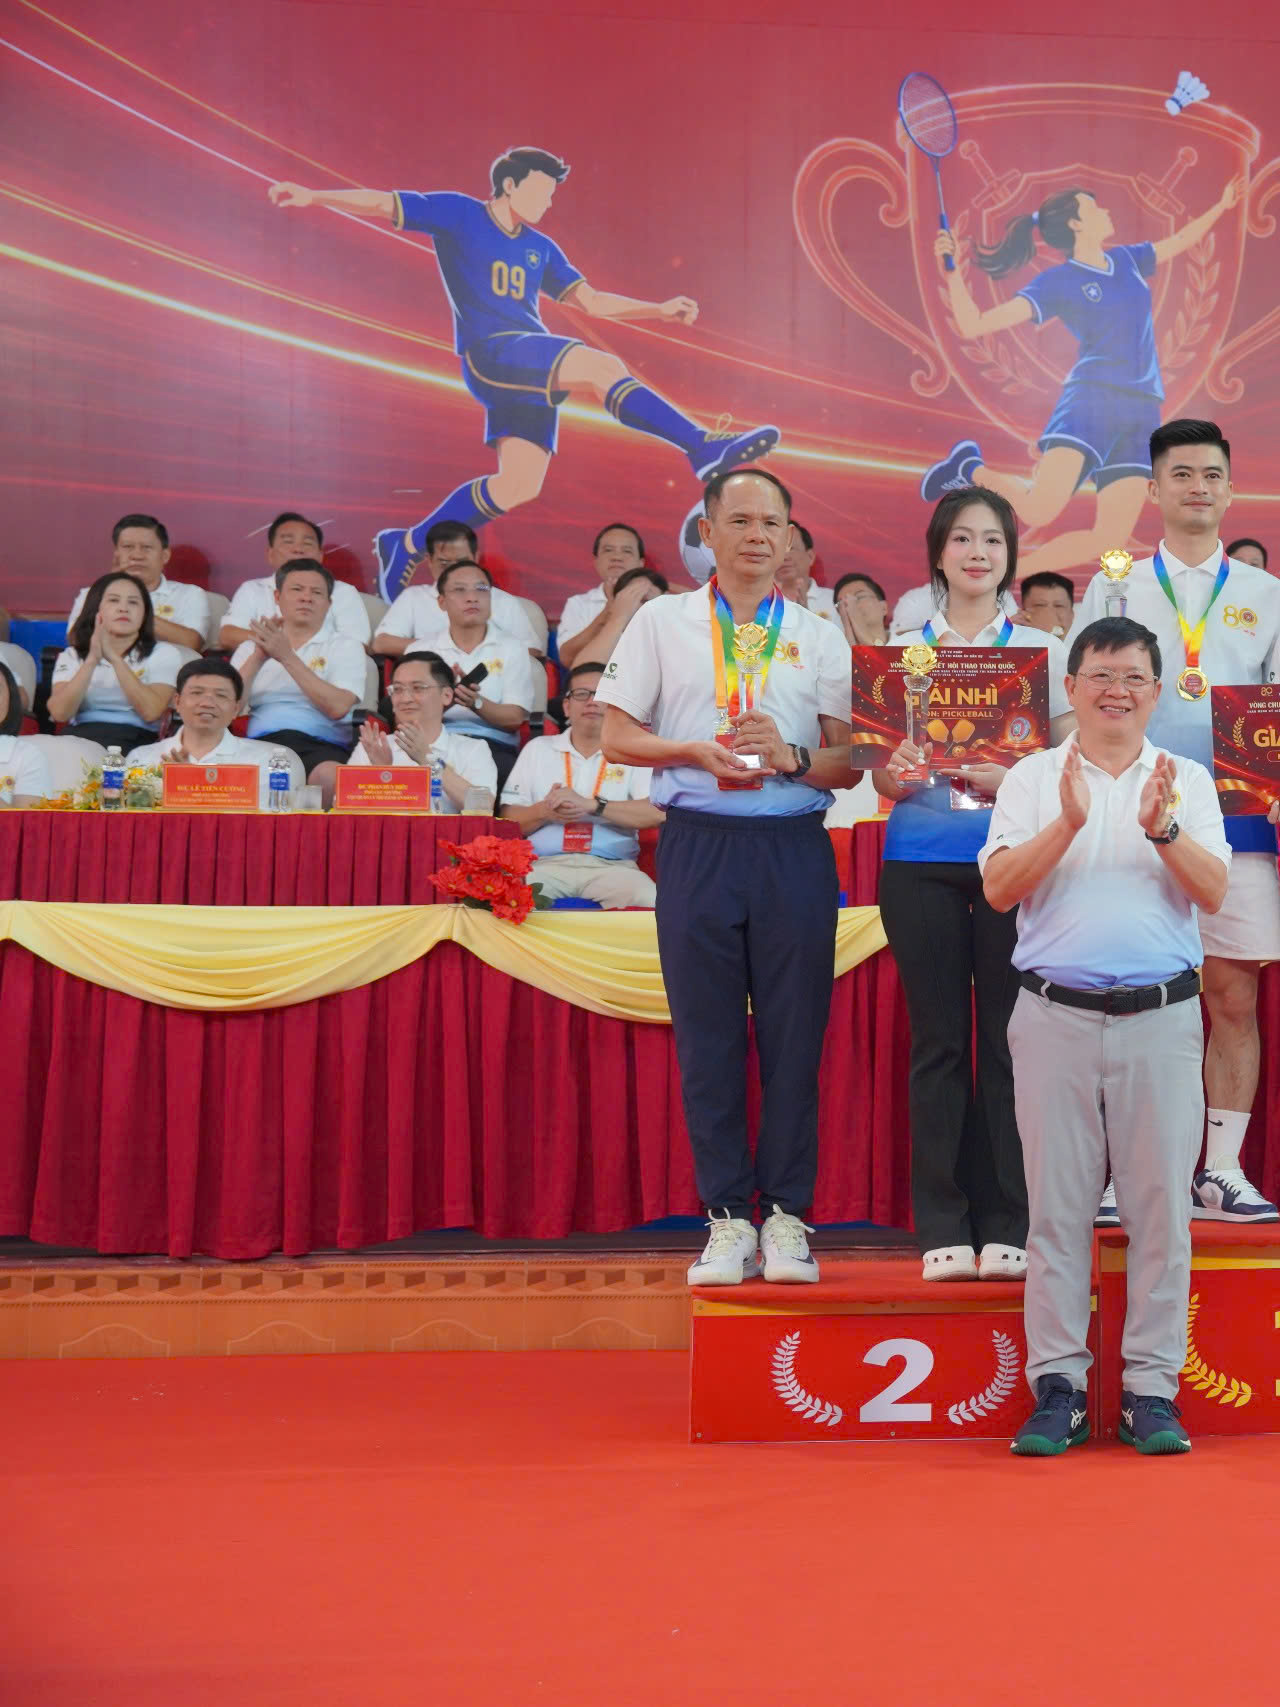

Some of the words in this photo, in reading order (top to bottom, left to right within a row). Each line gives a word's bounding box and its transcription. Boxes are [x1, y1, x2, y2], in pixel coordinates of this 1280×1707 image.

[491, 259, 526, 300] 09
[957, 683, 998, 706] NHÌ
[1248, 700, 1267, 709] VÒNG
[943, 710, 994, 718] PICKLEBALL
[859, 1338, 934, 1423] 2
